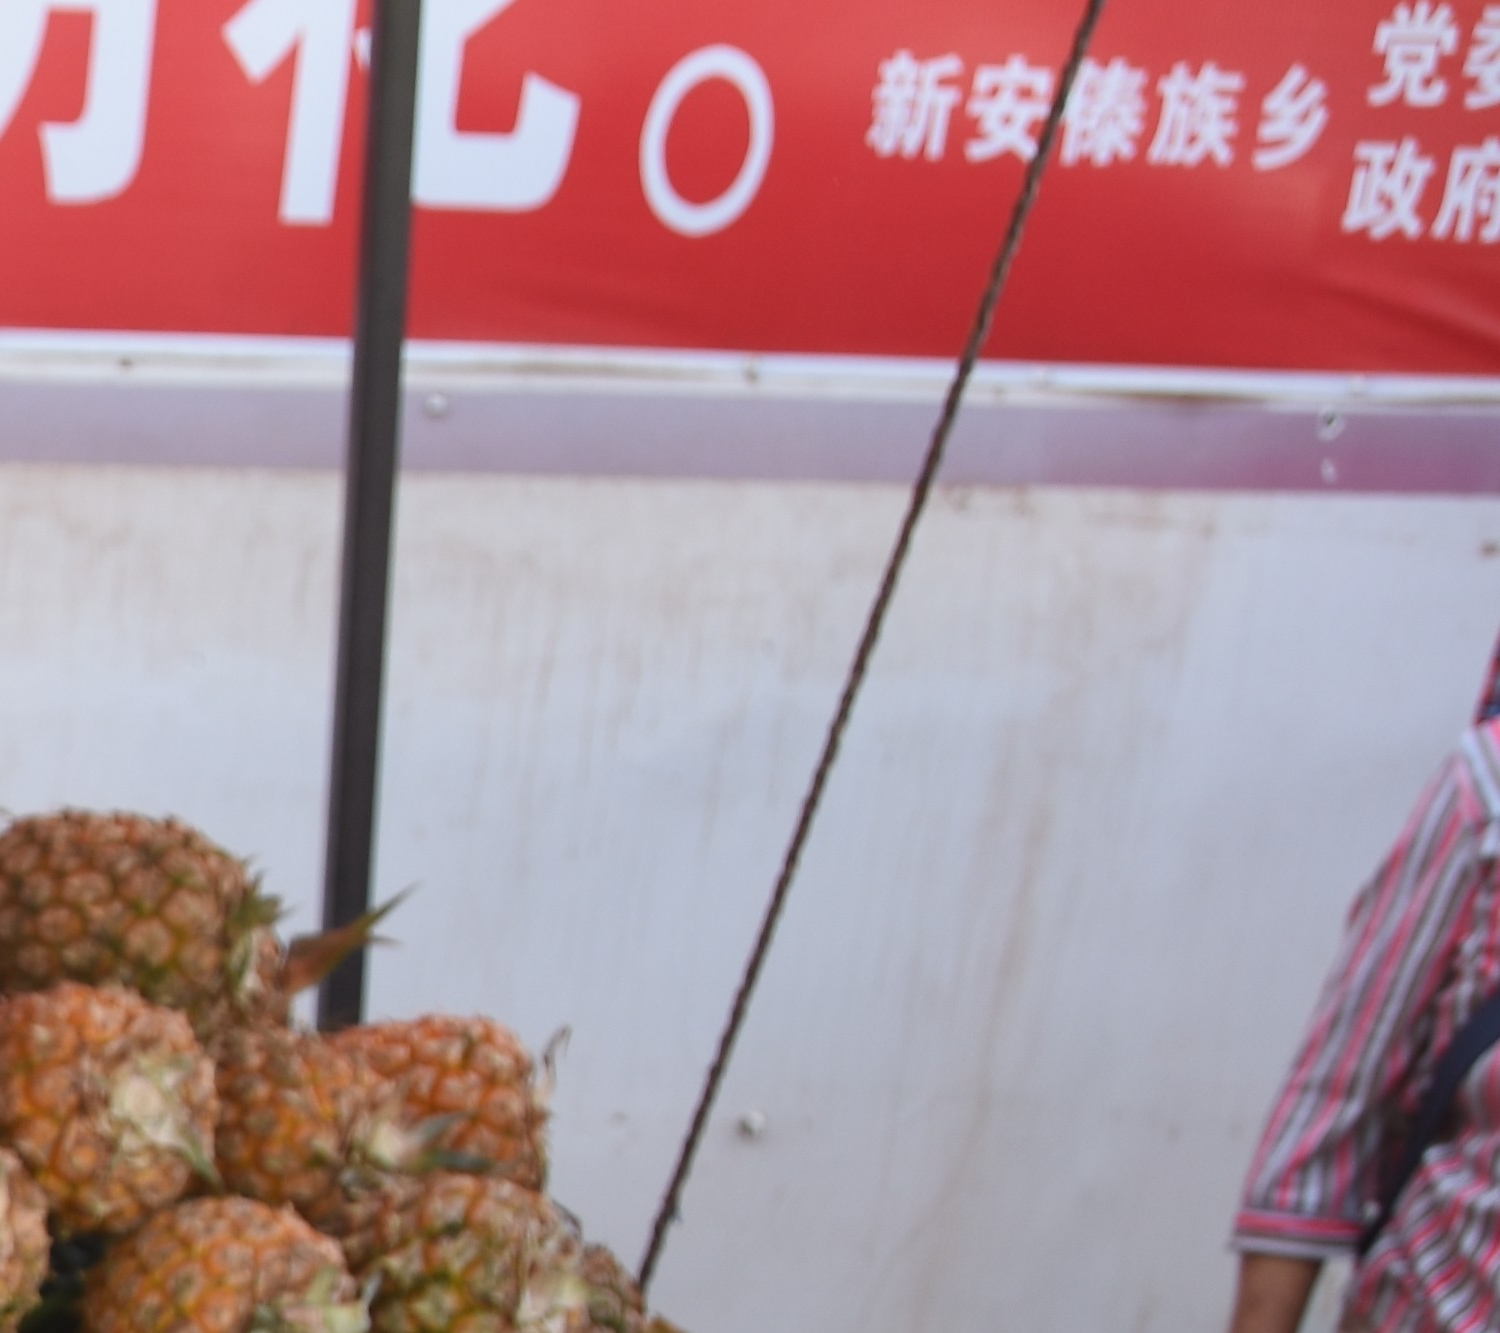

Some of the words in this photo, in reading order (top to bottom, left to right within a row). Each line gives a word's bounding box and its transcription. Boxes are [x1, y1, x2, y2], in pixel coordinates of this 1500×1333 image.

[866, 50, 1330, 171] 新安傣族乡
